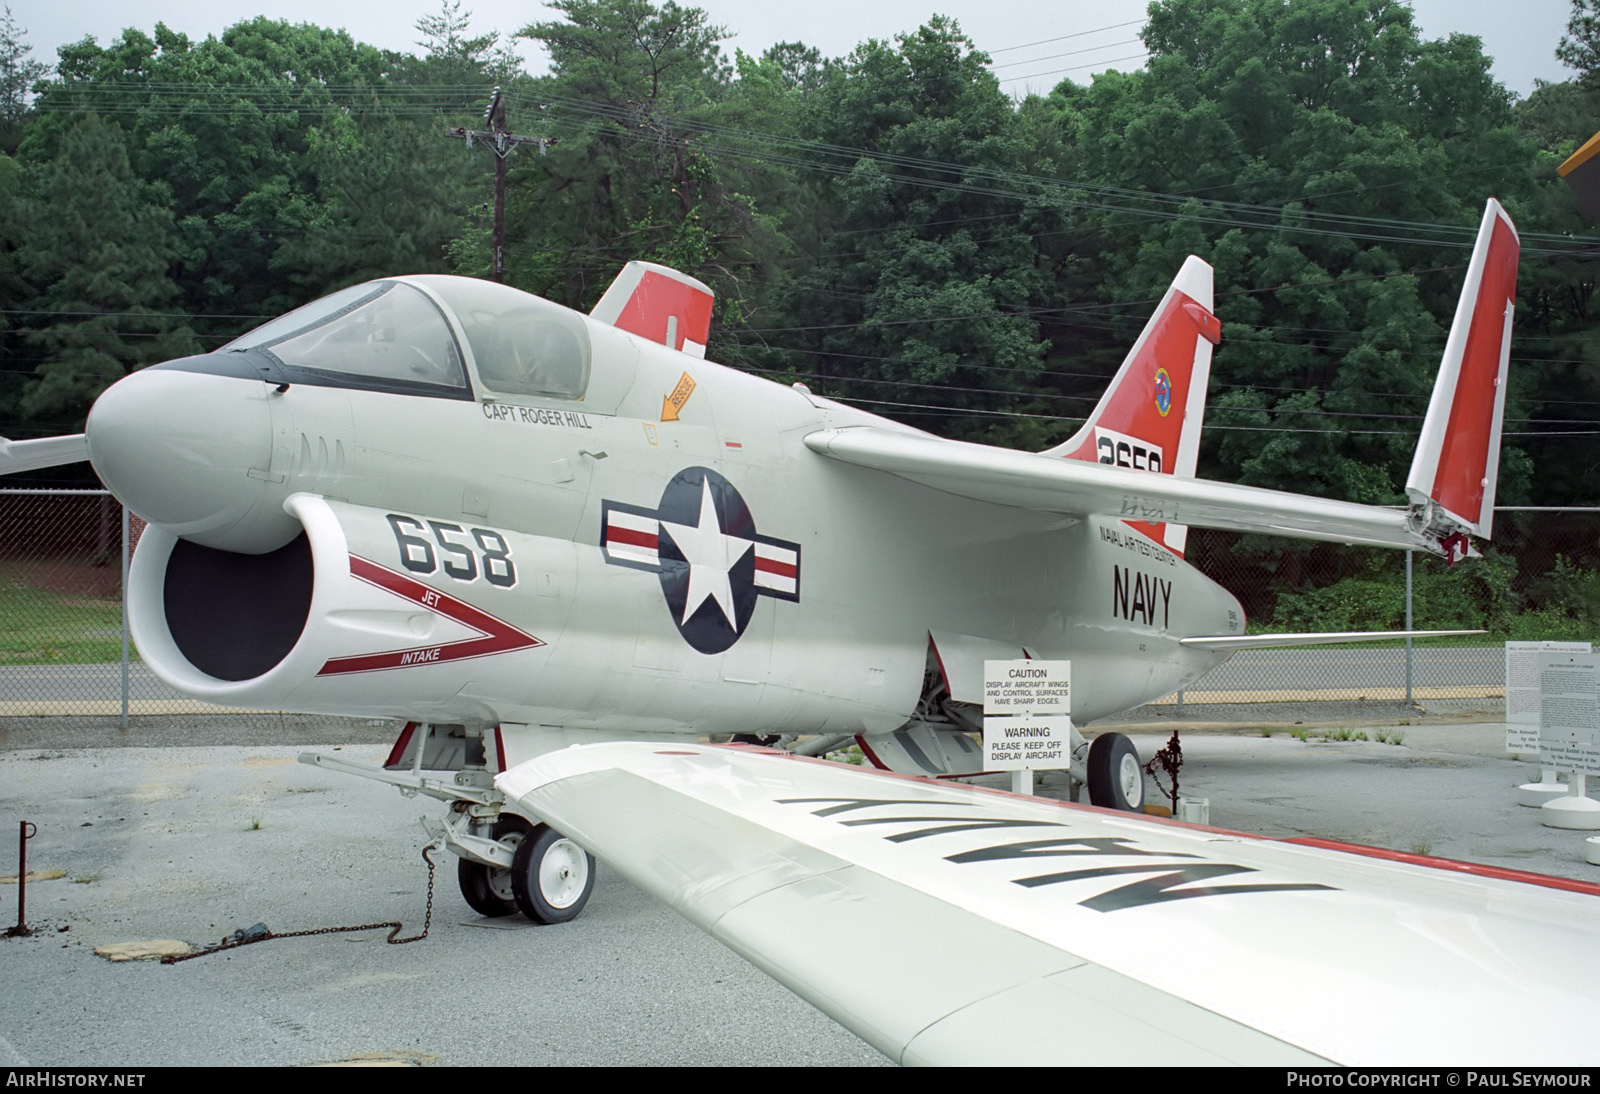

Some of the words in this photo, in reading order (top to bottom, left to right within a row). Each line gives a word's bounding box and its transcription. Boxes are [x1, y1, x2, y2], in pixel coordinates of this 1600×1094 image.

[671, 378, 692, 408] RESCUE
[482, 403, 517, 421] CAPT
[520, 407, 564, 427] ROGER
[567, 412, 593, 430] HILL
[385, 513, 519, 591] 658
[1099, 526, 1124, 548] NAVAL
[1135, 539, 1152, 558] TEST
[421, 590, 441, 607] JET
[1113, 564, 1171, 629] NAVY
[400, 648, 440, 664] INTAKE
[1008, 669, 1047, 678] CAUTION
[1004, 727, 1050, 737] WARNING
[991, 752, 1022, 760] DISPLAY
[1025, 751, 1062, 759] AIRCRAFT
[992, 742, 1020, 750] PLEASE
[1047, 741, 1061, 749] OFF
[773, 797, 1344, 914] NAVY
